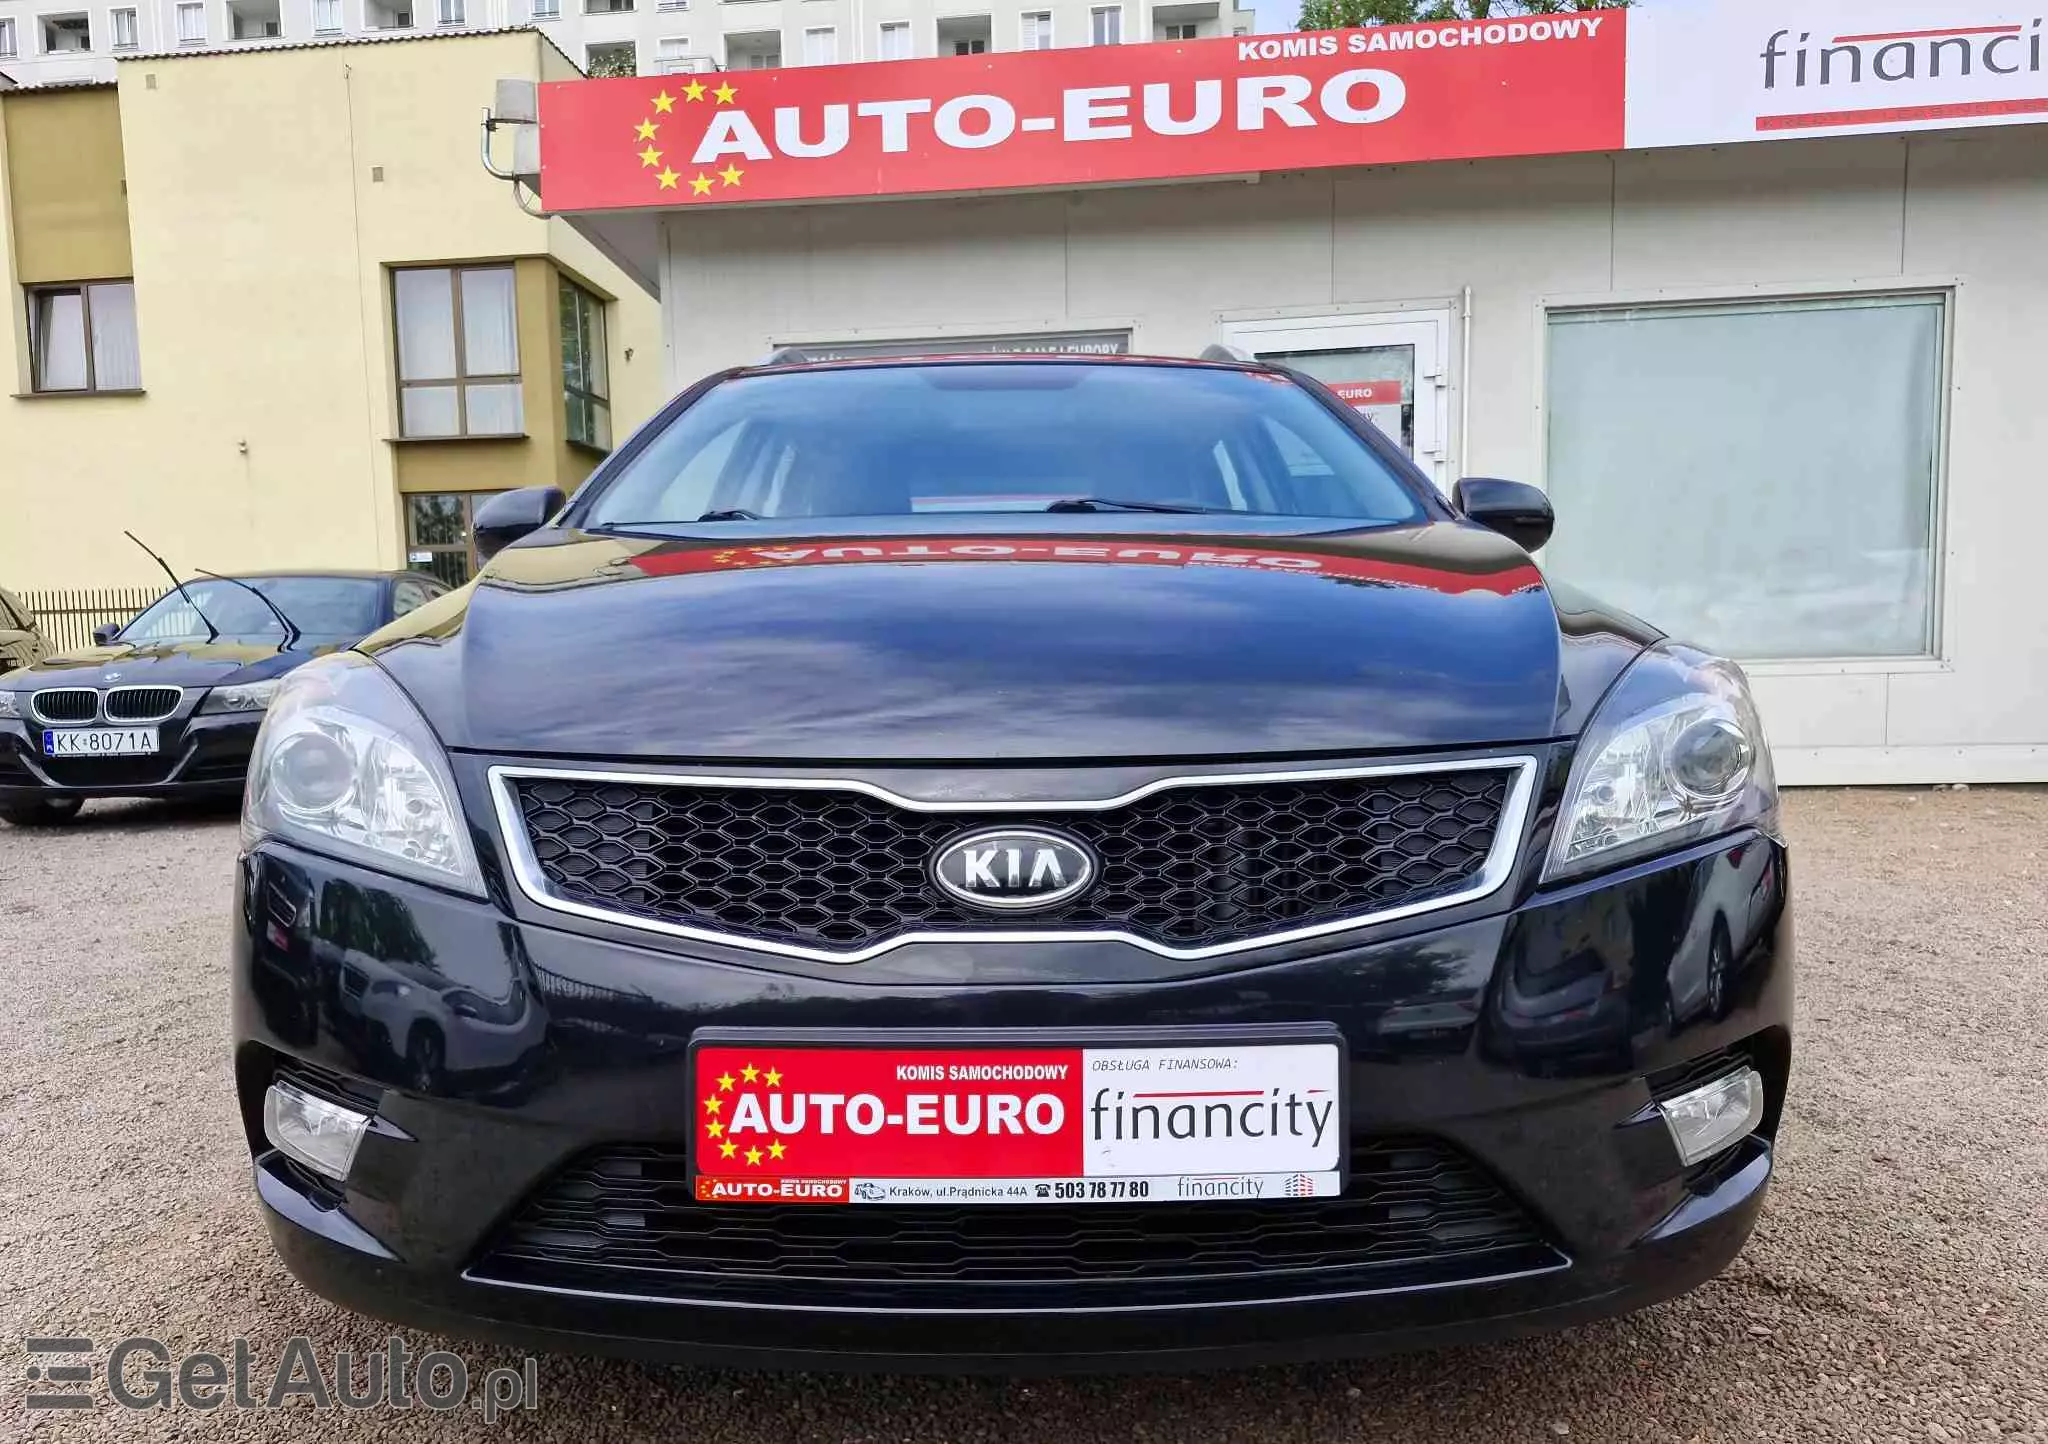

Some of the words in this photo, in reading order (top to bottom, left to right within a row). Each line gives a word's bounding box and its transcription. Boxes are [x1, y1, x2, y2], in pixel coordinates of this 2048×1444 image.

[1238, 39, 1338, 62] KOMIS
[1348, 17, 1603, 54] SAMOCHODOWY
[691, 68, 1407, 163] AUTO-EURO
[57, 734, 81, 751] KK
[89, 732, 152, 751] 8071A
[963, 848, 1067, 888] KIA
[896, 1065, 944, 1081] KOMIS
[949, 1064, 1069, 1080] SAMOCHODOWY
[1092, 1059, 1150, 1071] OBSŁUGA
[1158, 1058, 1238, 1070] FINANSOWA:
[728, 1093, 1066, 1135] AUTO-EURO
[1090, 1087, 1333, 1148] financity
[711, 1182, 843, 1197] AUTO-EURO
[1006, 1186, 1028, 1197] 44A
[1055, 1182, 1085, 1198] 503
[1088, 1182, 1106, 1198] 78
[1110, 1182, 1126, 1198] 77
[1129, 1181, 1149, 1197] 80
[1177, 1176, 1264, 1198] financity
